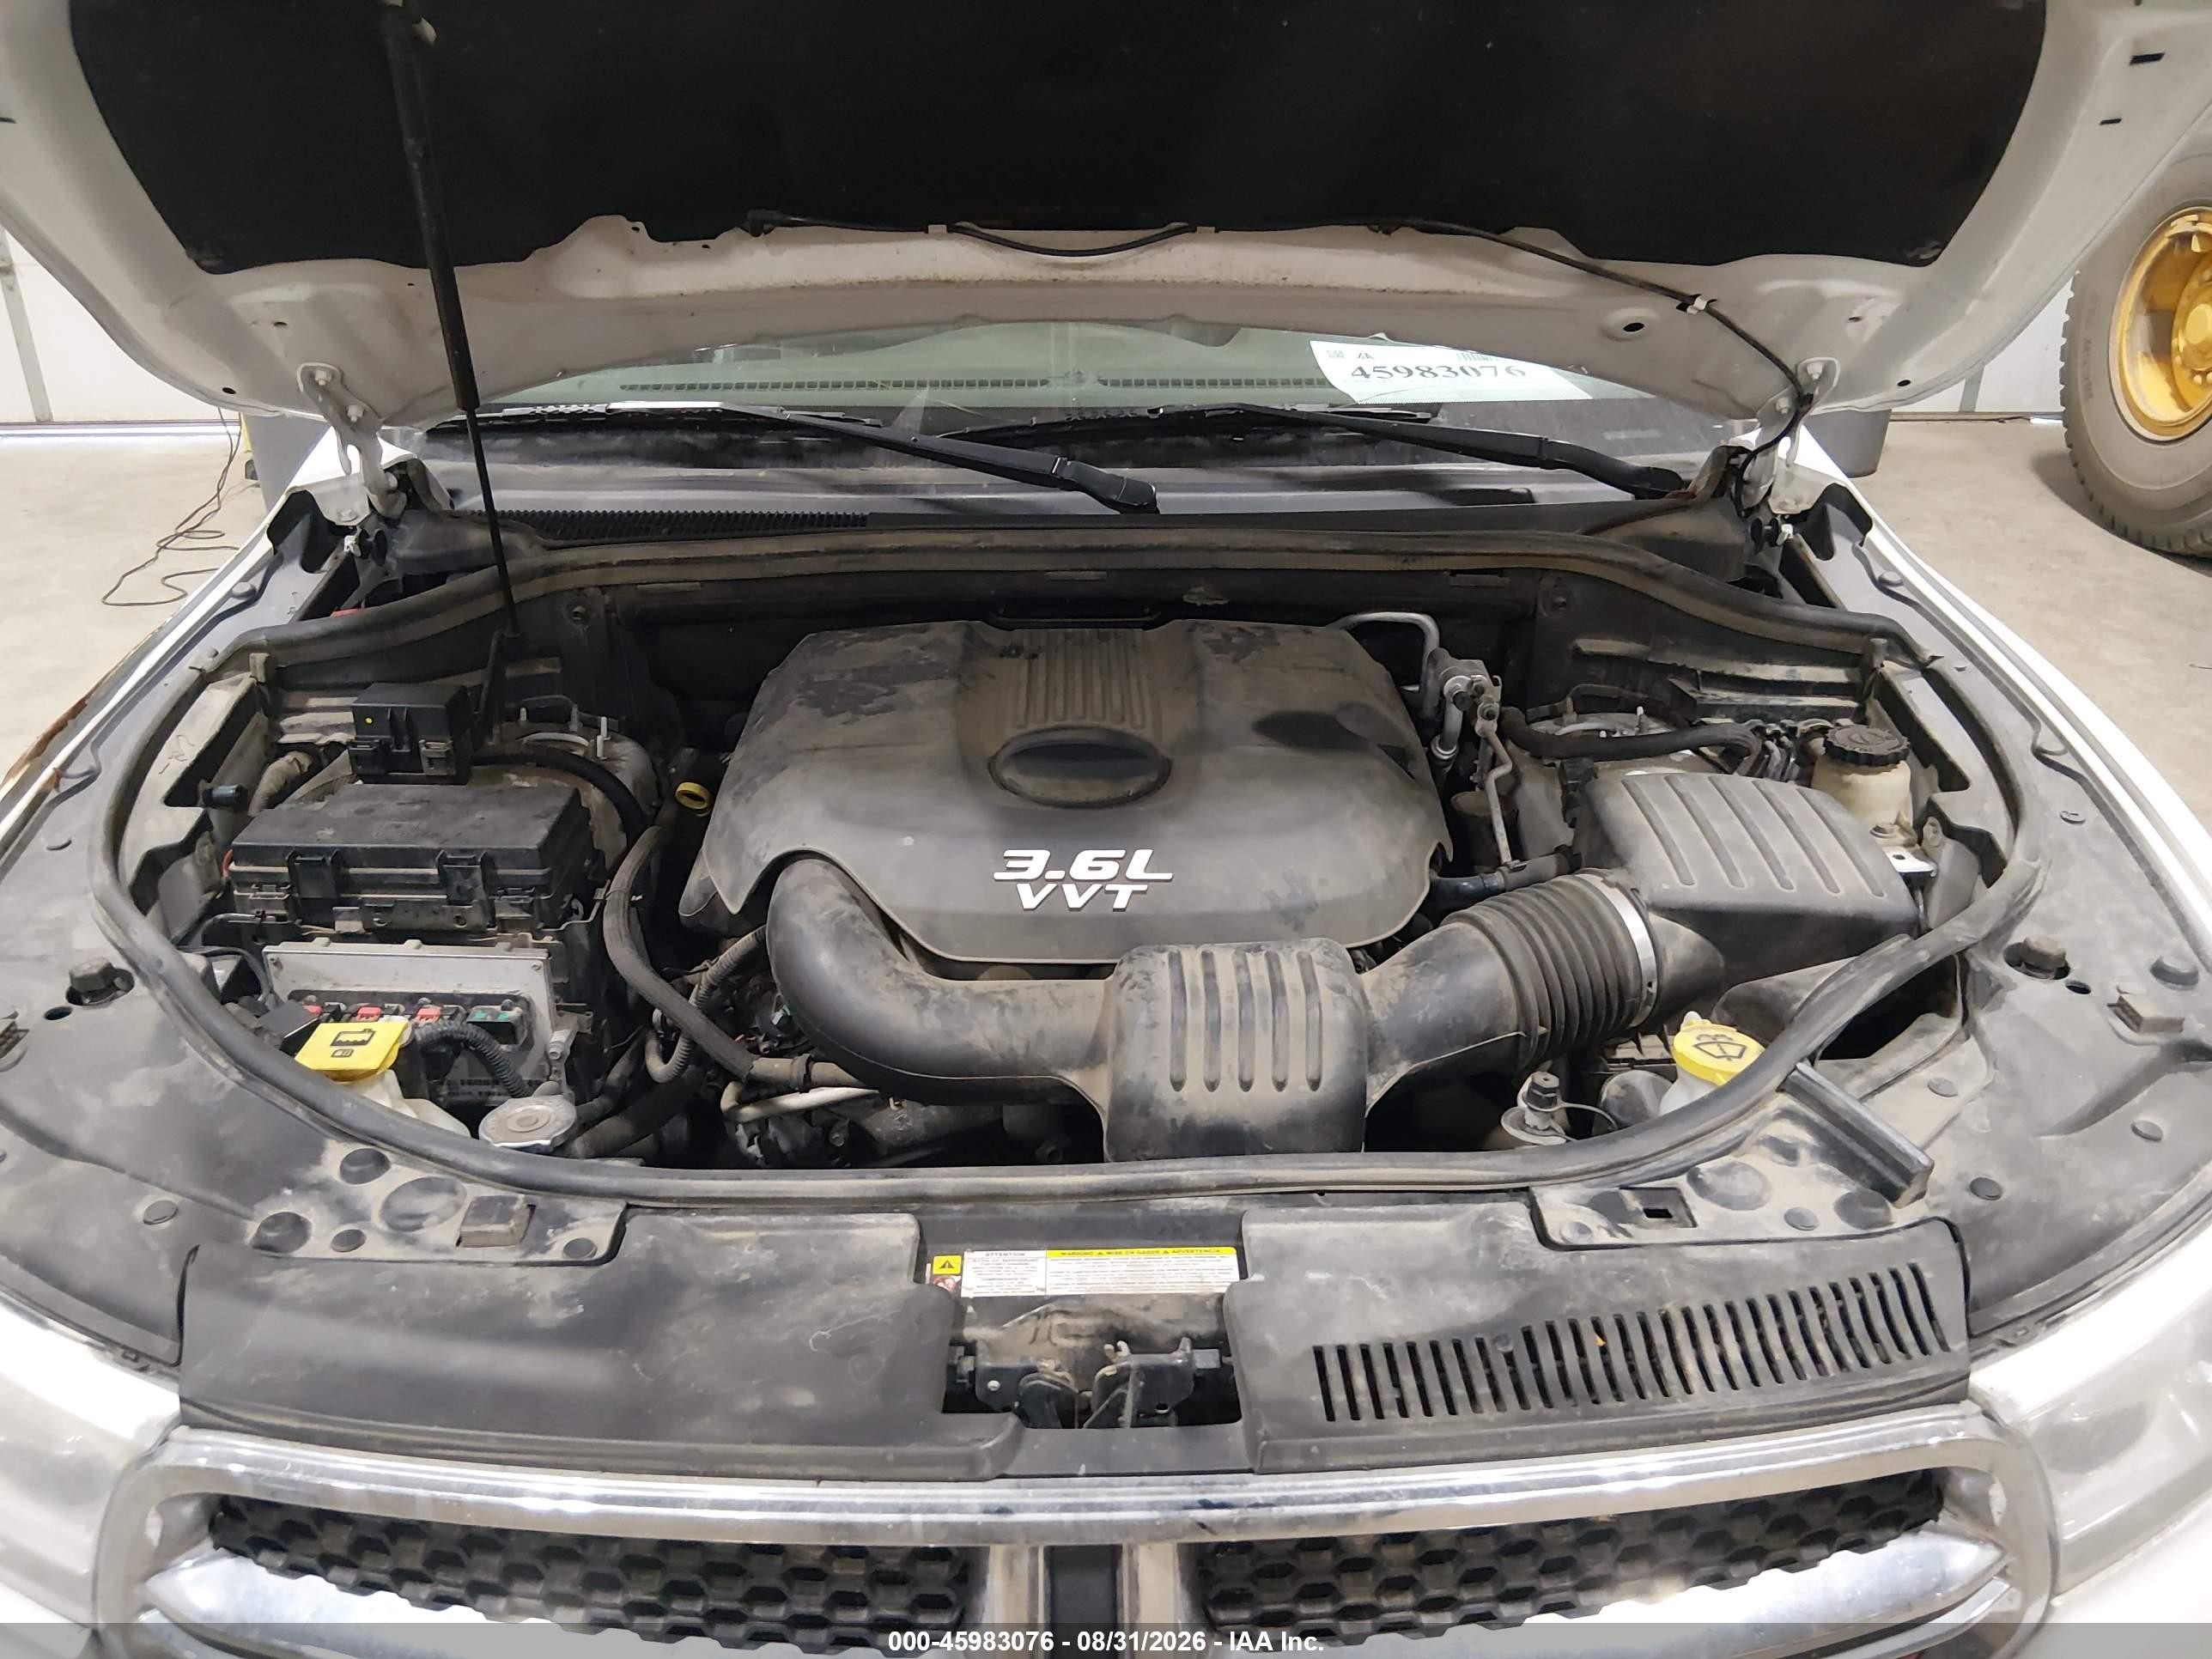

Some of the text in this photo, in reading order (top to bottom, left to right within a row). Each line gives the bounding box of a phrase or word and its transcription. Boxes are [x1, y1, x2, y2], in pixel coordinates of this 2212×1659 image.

[1351, 364, 1527, 380] 45983076
[993, 848, 1174, 880] 3.6L
[1016, 883, 1148, 911] VVT
